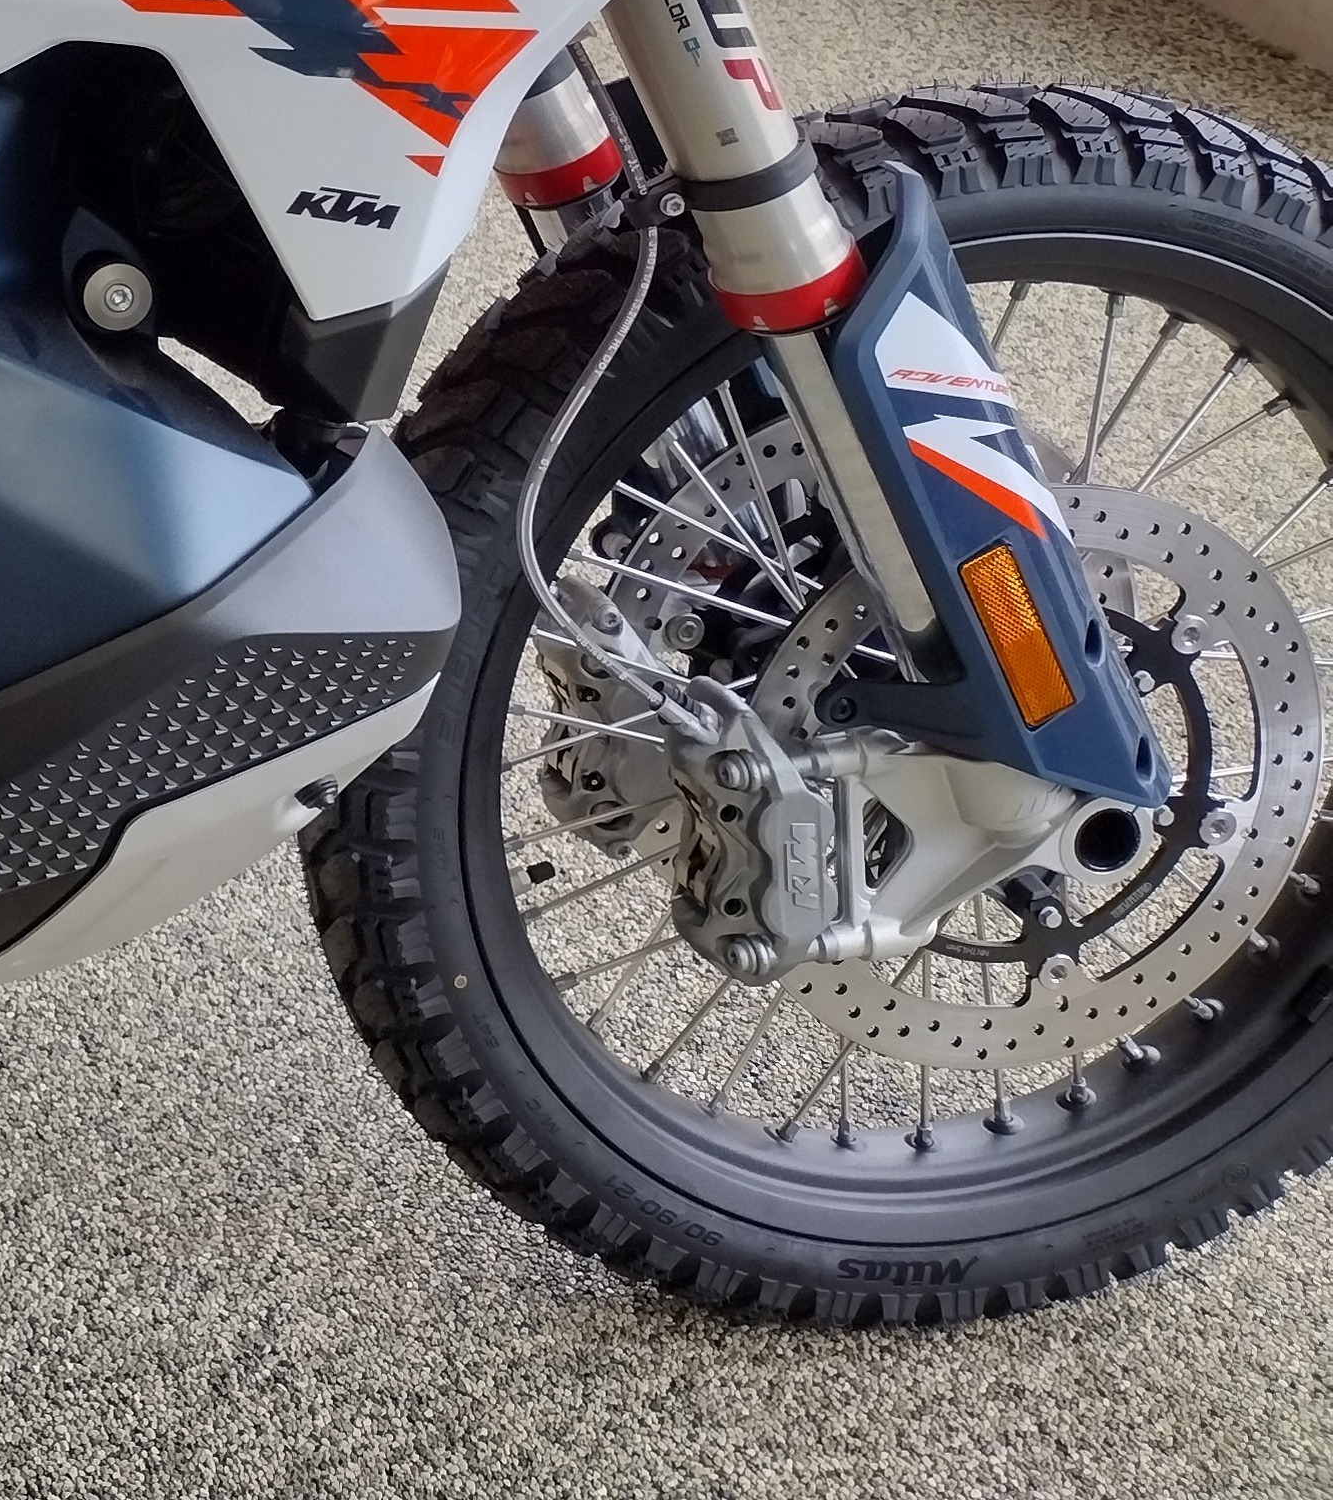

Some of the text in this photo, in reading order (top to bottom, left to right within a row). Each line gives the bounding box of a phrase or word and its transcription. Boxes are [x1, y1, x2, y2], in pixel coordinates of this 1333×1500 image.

[285, 185, 401, 231] KTM
[886, 368, 1010, 396] ADVENTURE
[784, 822, 817, 909] KTM
[836, 1255, 980, 1288] Mitas
